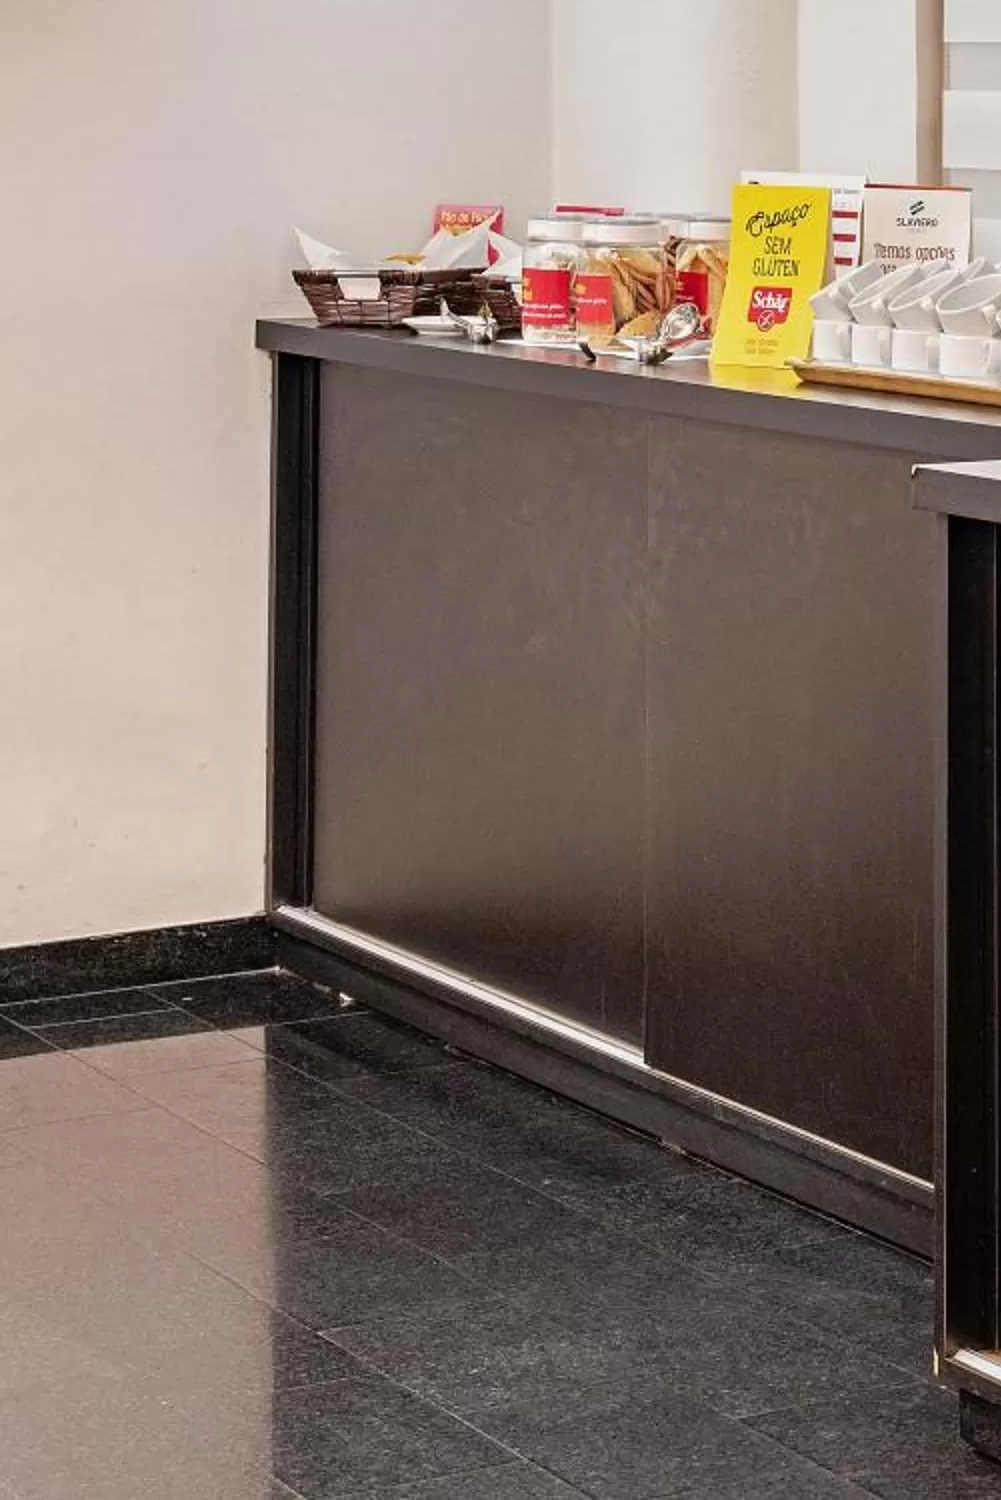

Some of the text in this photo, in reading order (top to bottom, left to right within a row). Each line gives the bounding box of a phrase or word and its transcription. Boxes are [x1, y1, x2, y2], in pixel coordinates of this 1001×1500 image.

[745, 203, 812, 237] Espaço
[763, 236, 792, 255] SEM
[873, 243, 955, 263] Temos opções
[753, 258, 800, 277] GLUTEN
